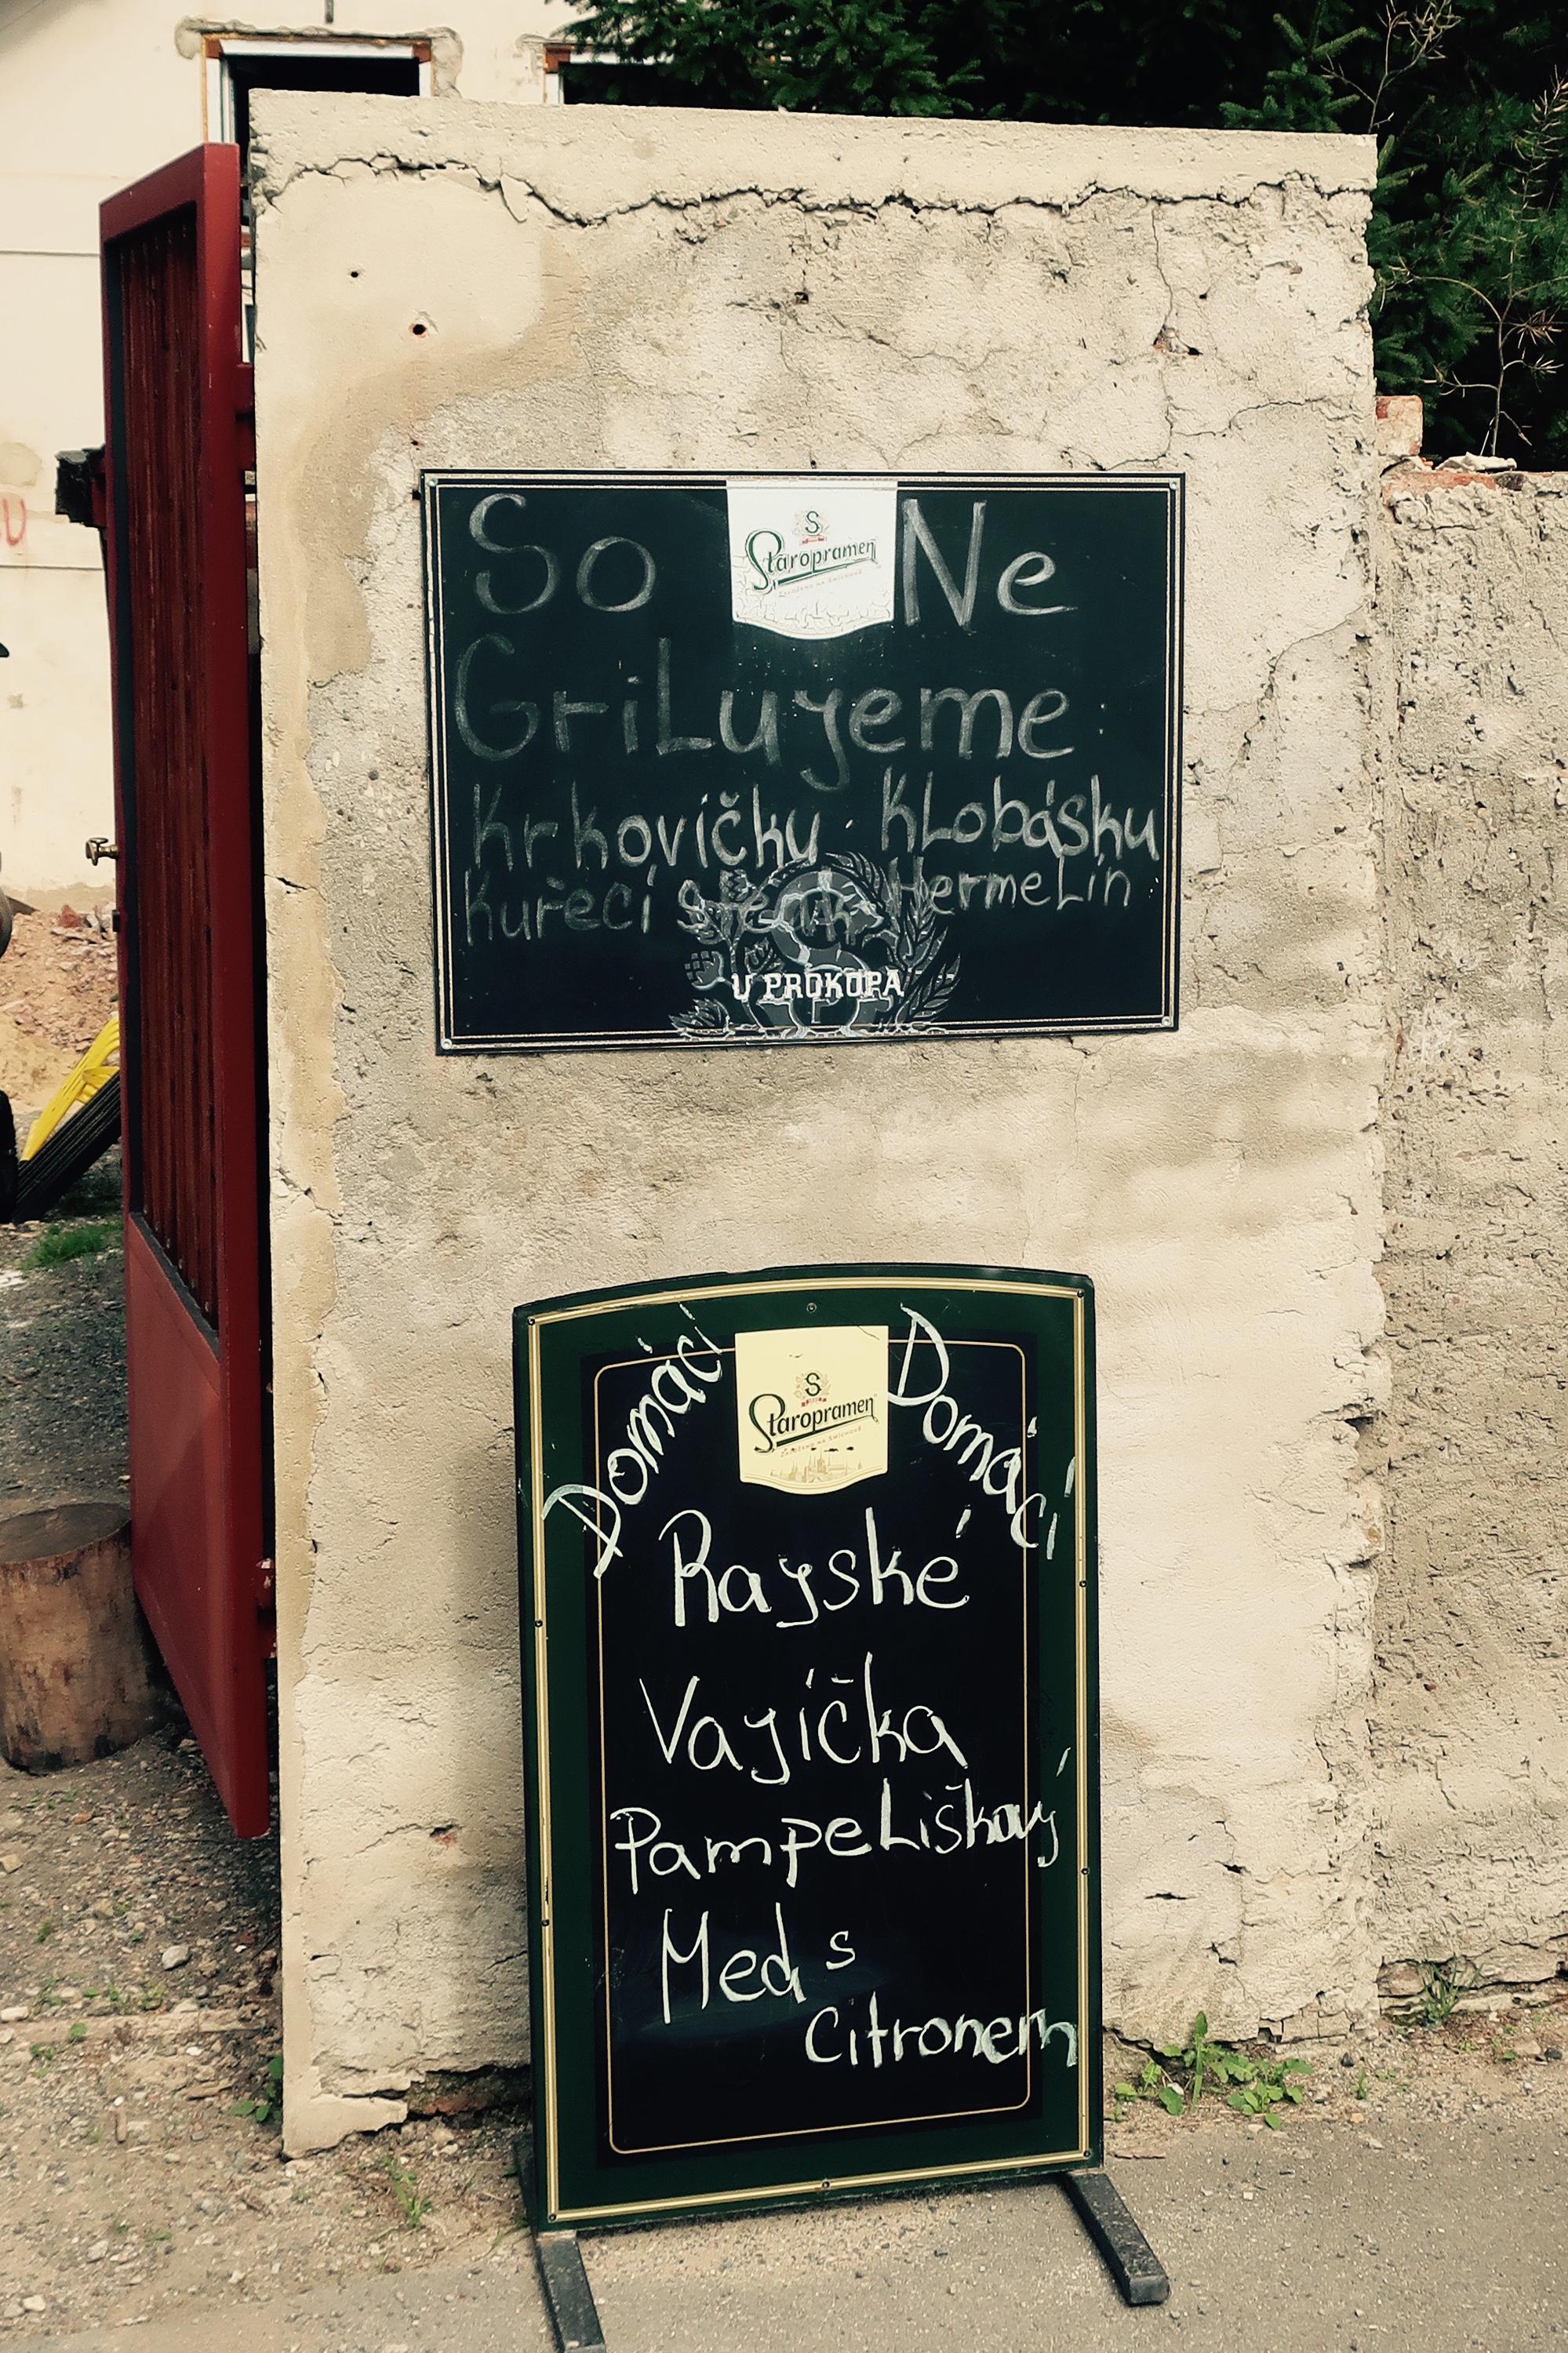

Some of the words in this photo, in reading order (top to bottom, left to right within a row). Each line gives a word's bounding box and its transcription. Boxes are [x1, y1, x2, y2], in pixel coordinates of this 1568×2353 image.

[469, 493, 656, 615] So
[902, 499, 1079, 630] Ne
[746, 529, 877, 591] Staropramen
[731, 971, 754, 1002] U
[763, 966, 905, 999] PROKOPA
[543, 1301, 722, 1580] Domácí
[749, 1393, 875, 1453] Staropramen
[888, 1303, 1076, 1560] Domácí
[662, 1902, 806, 2024] Med
[826, 1930, 857, 1970] s
[805, 1991, 1078, 2068] Citronem
